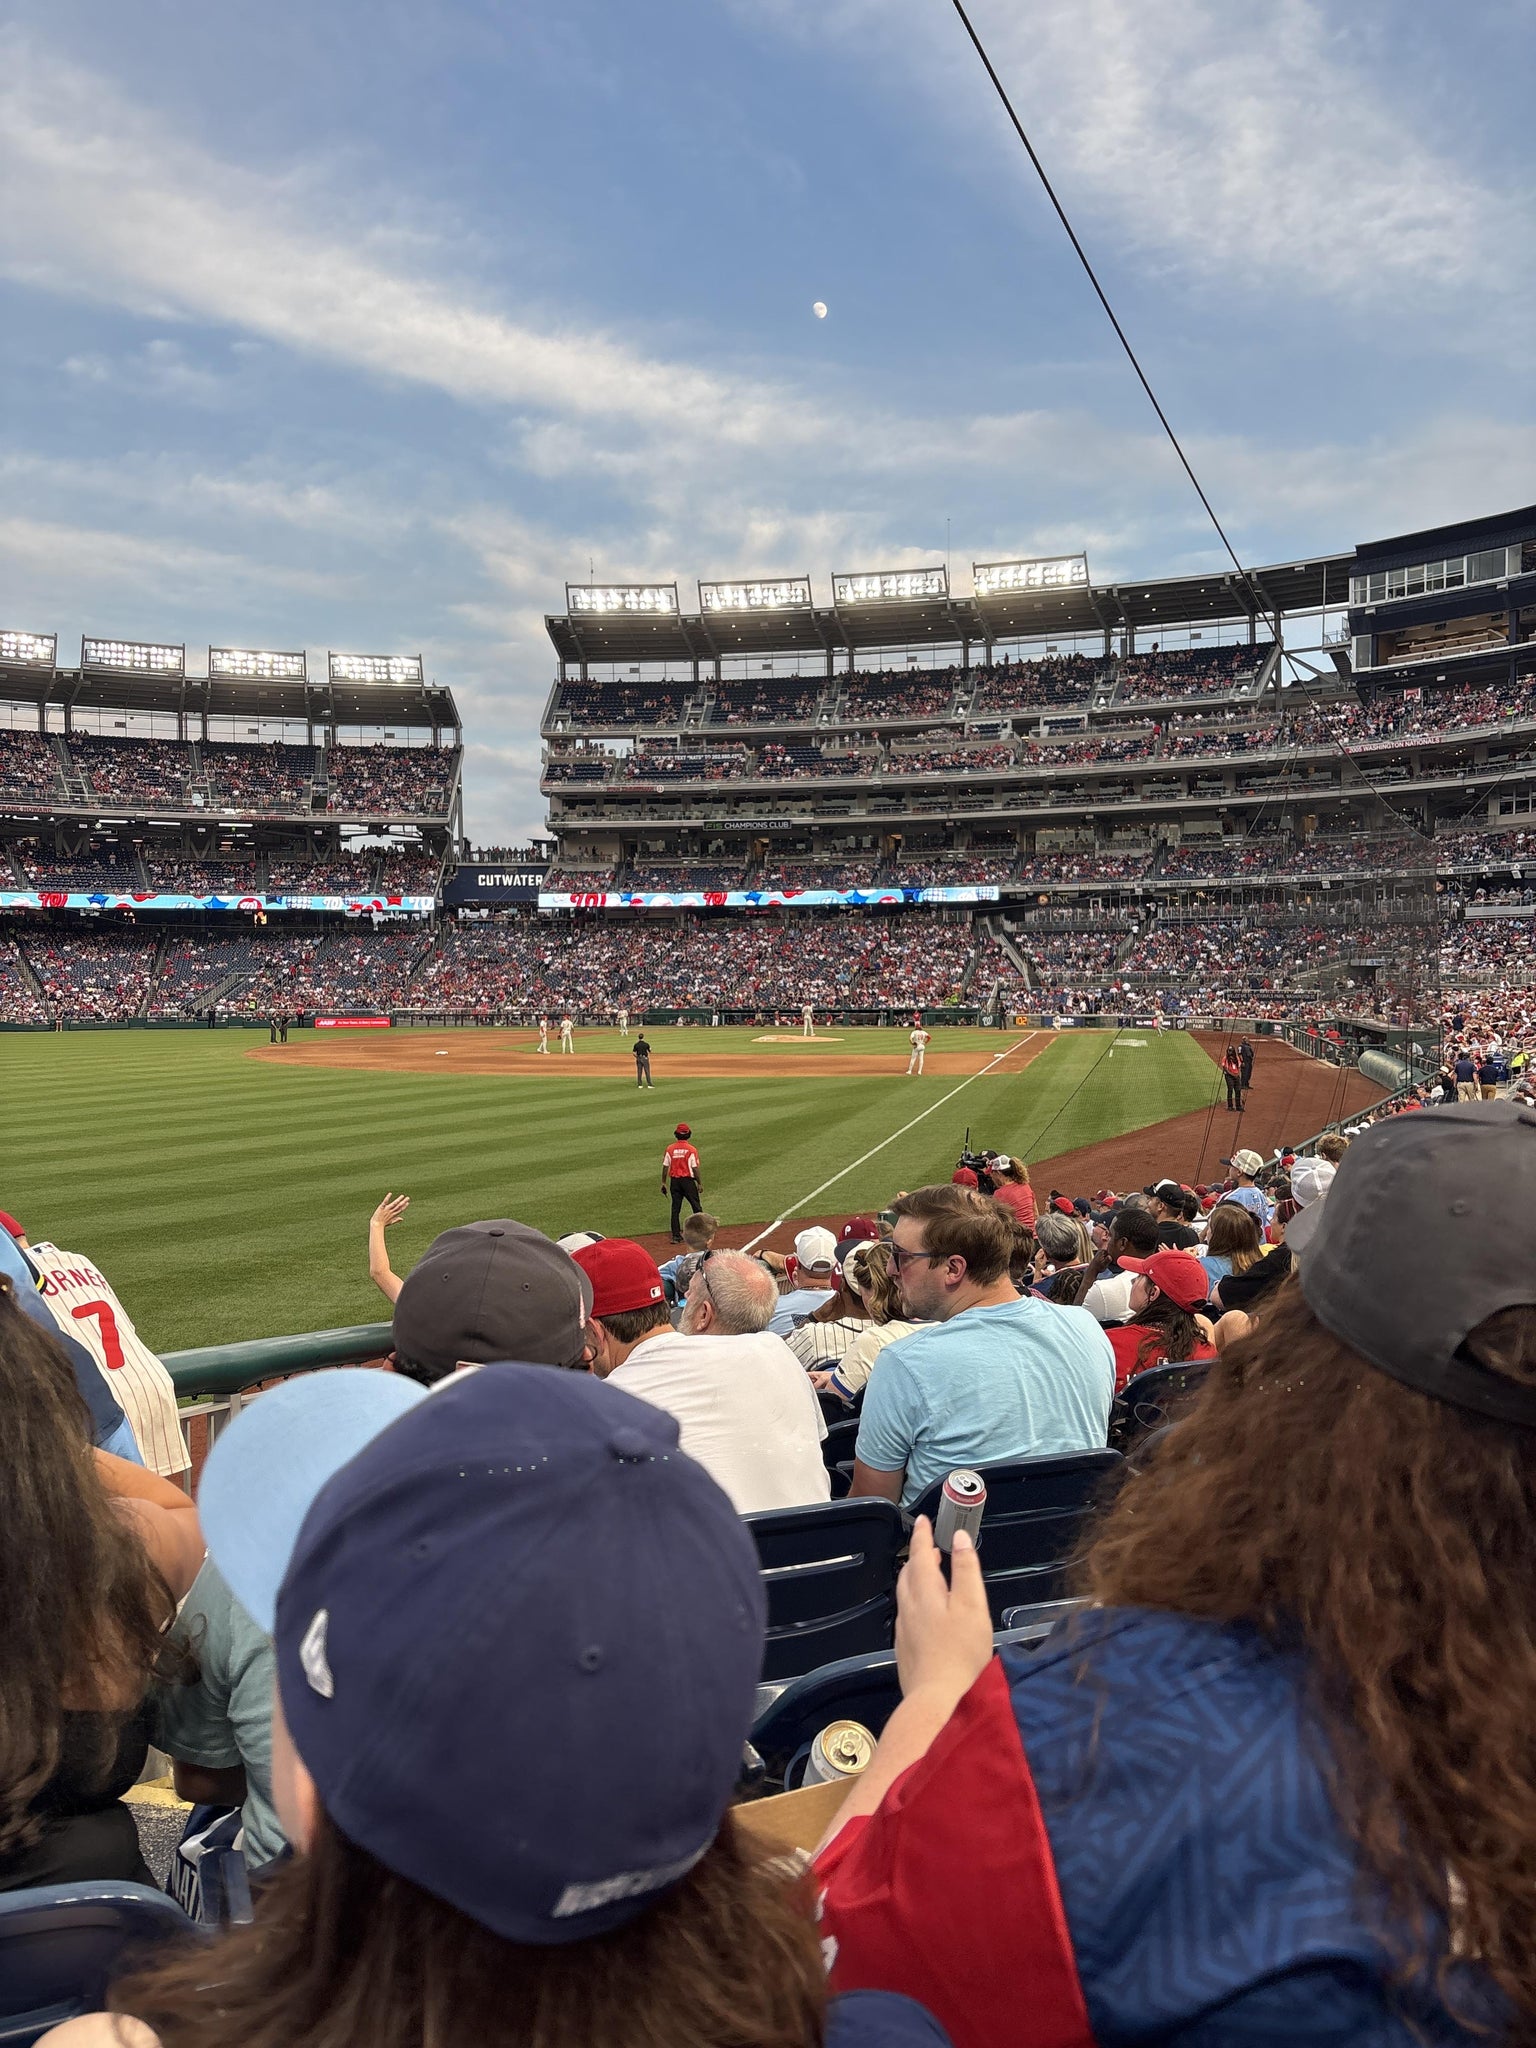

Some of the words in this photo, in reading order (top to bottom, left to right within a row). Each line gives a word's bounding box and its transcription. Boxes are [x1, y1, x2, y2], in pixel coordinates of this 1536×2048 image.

[1363, 742, 1404, 751] WASHINGTON
[1404, 737, 1440, 747] NATIONALS
[724, 822, 768, 830] CHAMPIONS
[769, 821, 790, 829] CLUB
[478, 874, 543, 886] CUTWATER
[1050, 895, 1072, 905] PNC
[844, 1225, 852, 1237] P
[72, 1300, 125, 1369] 7
